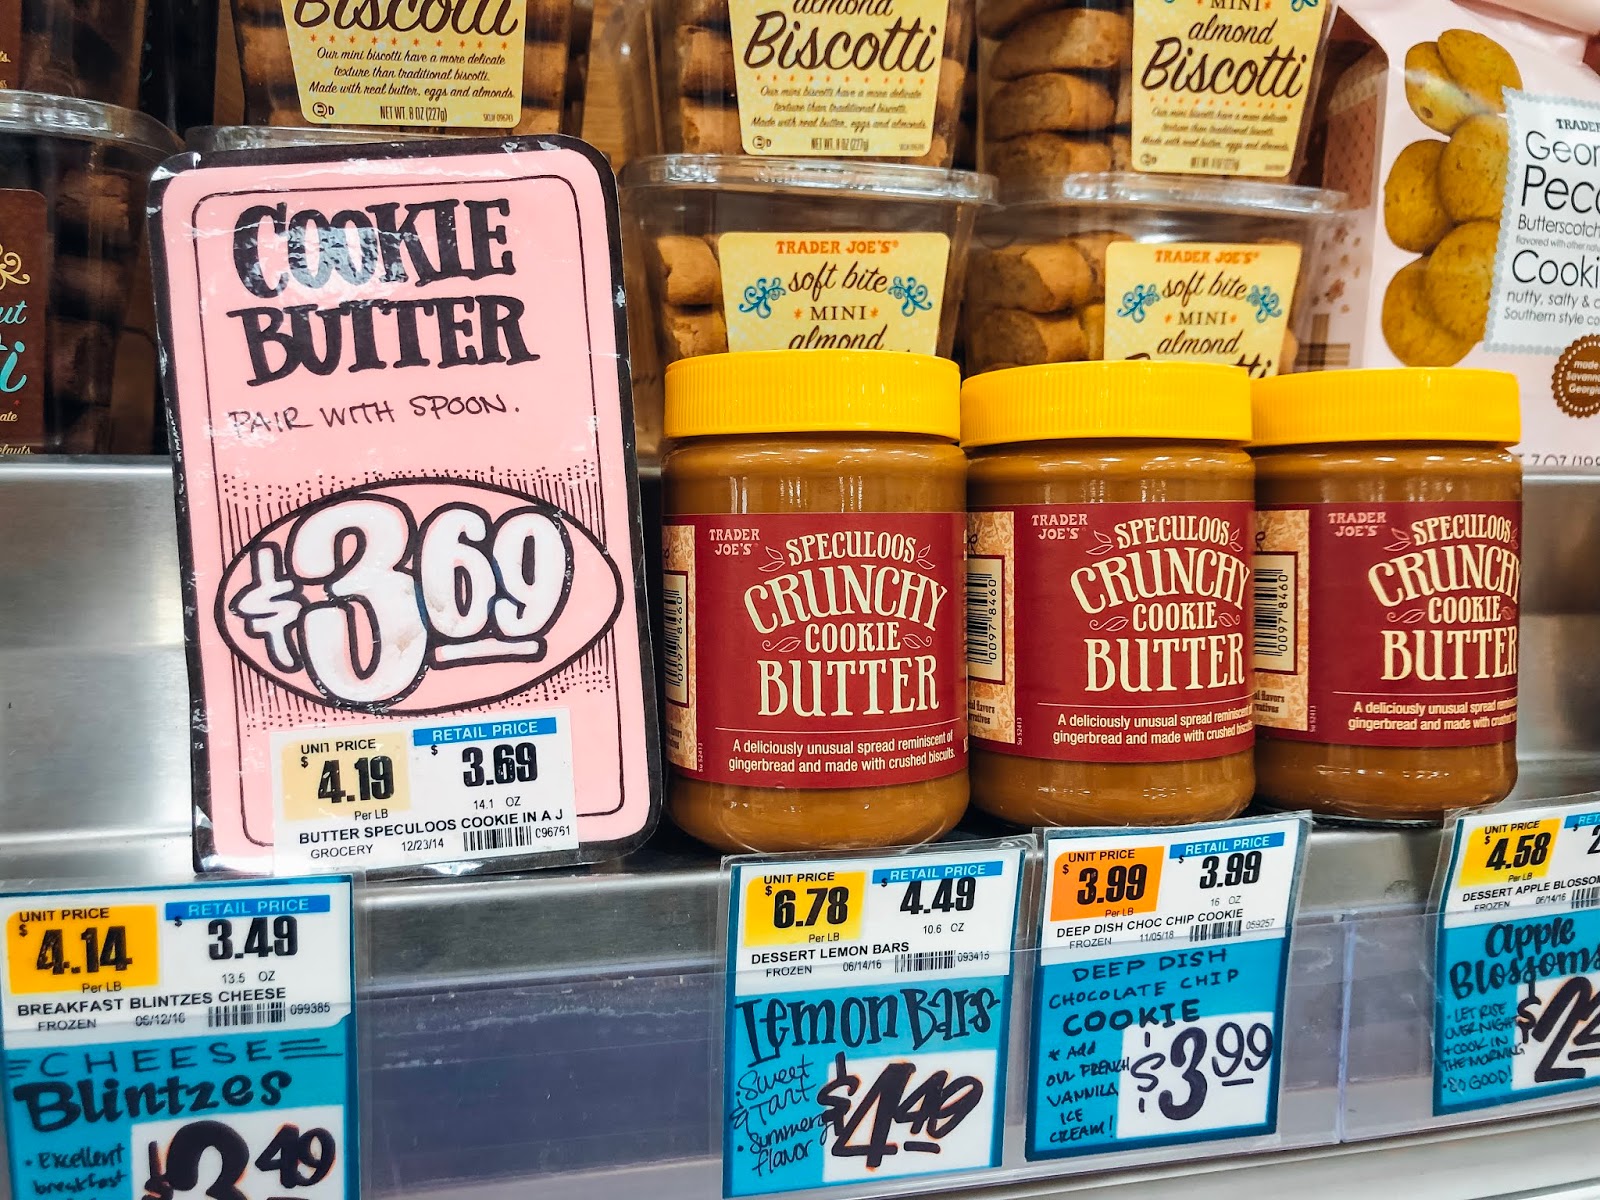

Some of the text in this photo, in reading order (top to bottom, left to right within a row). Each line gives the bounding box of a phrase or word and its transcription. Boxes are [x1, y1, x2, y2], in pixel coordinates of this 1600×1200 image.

[743, 10, 938, 73] Biscotti
[1188, 13, 1279, 45] almond
[317, 46, 506, 66] Our mini biscotti have a more delicate
[1141, 36, 1308, 99] Biscotti
[334, 66, 370, 78] texture
[373, 67, 396, 79] than
[398, 68, 452, 80] traditional
[309, 81, 338, 94] Made
[340, 82, 361, 95] with
[363, 83, 386, 96] real
[424, 88, 448, 102] eggs
[450, 85, 470, 98] and
[380, 105, 394, 119] NET
[409, 106, 415, 119] 8
[416, 106, 426, 120] OZ
[426, 106, 448, 122] (227g)
[232, 198, 516, 299] COOKIE
[776, 239, 893, 255] TRADER JOE'S
[1155, 250, 1211, 264] TRADER
[788, 260, 888, 302] soft bite
[1162, 270, 1248, 308] soft bite
[810, 305, 868, 321] MINI
[1507, 289, 1578, 309] nutty, salty
[1177, 312, 1227, 326] MINI
[1504, 307, 1584, 326] Southern style
[226, 294, 541, 387] BUTTER
[788, 324, 888, 350] almond
[1156, 329, 1244, 356] almond
[227, 394, 520, 436] PAIR WITH SPOON.
[709, 528, 761, 542] TRADER
[1114, 515, 1232, 550] SPECULOOS
[1411, 513, 1512, 547] SPECULOOS
[715, 543, 752, 556] JOE'S
[785, 531, 917, 567] SPECULOOS
[1069, 546, 1251, 615] CRUNCHY
[743, 564, 949, 634] CRUNCHY
[1428, 595, 1502, 624] COOKIE
[1132, 601, 1218, 632] COOKIE
[804, 621, 902, 654] COOKIE
[1083, 632, 1246, 693] BUTTER
[1380, 625, 1518, 682] BUTTER
[756, 654, 940, 717] BUTTER
[336, 738, 377, 753] PRICE
[432, 721, 538, 742] RETAIL PRICE
[733, 729, 954, 758] A deliciously unusual spread reminiscent of
[462, 742, 538, 788] 3.69
[728, 747, 957, 774] gingerbread and made with crushed biscuits.
[317, 755, 395, 804] 4.19
[354, 809, 389, 822] Per LB
[473, 796, 521, 811] 14.1 OZ
[299, 809, 564, 846] BUTTER SPECULOOS COOKIE IN A J
[1484, 820, 1541, 835] UNIT PRICE
[310, 838, 445, 860] GROCERY 12/23/14
[1068, 849, 1136, 864] UNIT PRICE
[1185, 836, 1270, 856] RETAIL PRICE
[1485, 832, 1552, 871] 4.58
[763, 871, 835, 885] UNIT PRICE
[890, 864, 986, 881] RETAIL PRICE
[1076, 863, 1148, 906] 3.99
[1199, 850, 1263, 890] 3.99
[188, 898, 310, 917] RETAIL PRICE
[773, 886, 850, 929] 6.78
[899, 876, 977, 915] 4.49
[1462, 881, 1551, 903] DESSERT APPLE
[19, 907, 110, 924] UNIT PRICE
[1057, 908, 1244, 939] DEEP DISH CHOC CHIP COOKIE
[36, 925, 133, 976] 4.14
[207, 915, 298, 962] 3.49
[751, 942, 910, 965] DESSERT LEMON BARS
[766, 965, 813, 978] FROZEN
[1072, 948, 1228, 982] DEEP DISH
[17, 987, 287, 1018] BREAKFAST BLINTZES CHEESE
[1048, 968, 1239, 1010] CHOCOLATE CHIP
[38, 1018, 97, 1031] FROZEN
[735, 987, 1000, 1068] Lemon Bars
[1063, 998, 1201, 1037] COOKIE
[39, 1039, 273, 1078] CHEESE
[738, 1054, 814, 1100] Sweet
[12, 1070, 293, 1133] Blintzes
[38, 1142, 125, 1170] Excellent
